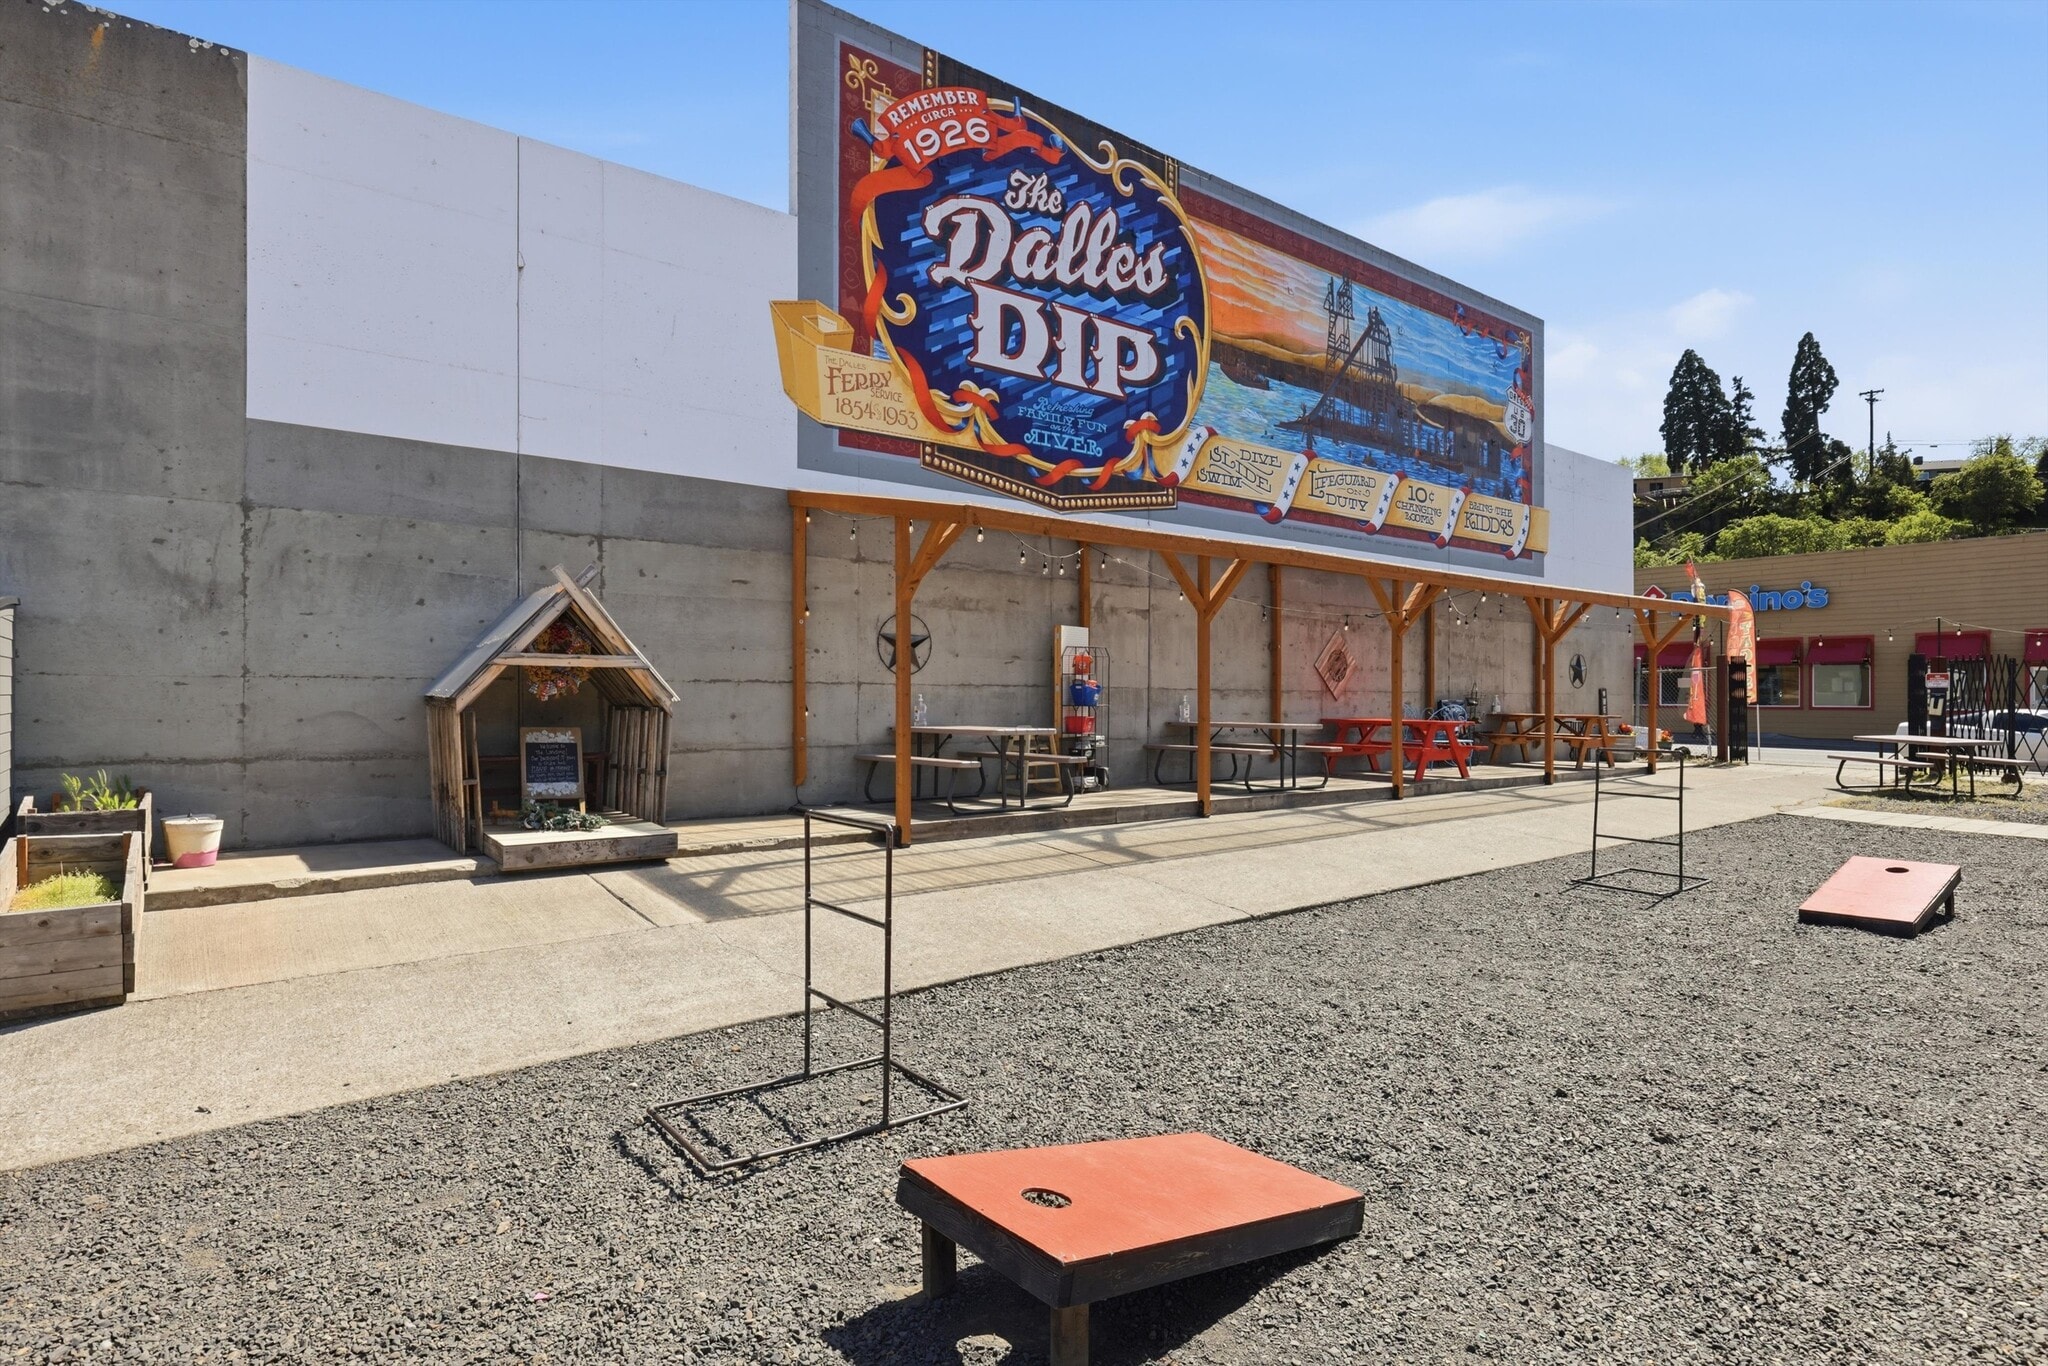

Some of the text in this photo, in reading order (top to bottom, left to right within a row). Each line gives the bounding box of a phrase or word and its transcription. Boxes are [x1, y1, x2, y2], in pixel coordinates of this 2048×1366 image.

[887, 90, 979, 127] REMEMBER
[921, 107, 957, 124] CIRCA
[903, 117, 990, 164] 1926
[1004, 168, 1063, 214] The
[921, 195, 1168, 294] Dalles
[966, 277, 1160, 399] DIP
[839, 357, 867, 370] DALLES
[824, 366, 892, 395] FERRY
[870, 387, 904, 404] SERVICE
[1033, 396, 1095, 418] Refreshing
[836, 396, 919, 430] 1854 1953
[1017, 406, 1108, 433] FAMILY FUN
[1023, 428, 1103, 457] RIVER
[1209, 446, 1272, 493] SLIDE
[1239, 448, 1282, 468] DIVE
[1196, 468, 1242, 489] SWIM
[1308, 469, 1377, 498] LIFEGUARD
[1326, 493, 1369, 512] DUTY
[1395, 501, 1442, 517] CHANGING
[1469, 501, 1513, 518] BRING THE
[1464, 511, 1514, 537] KIDDOS
[1670, 581, 1829, 615] ino's
